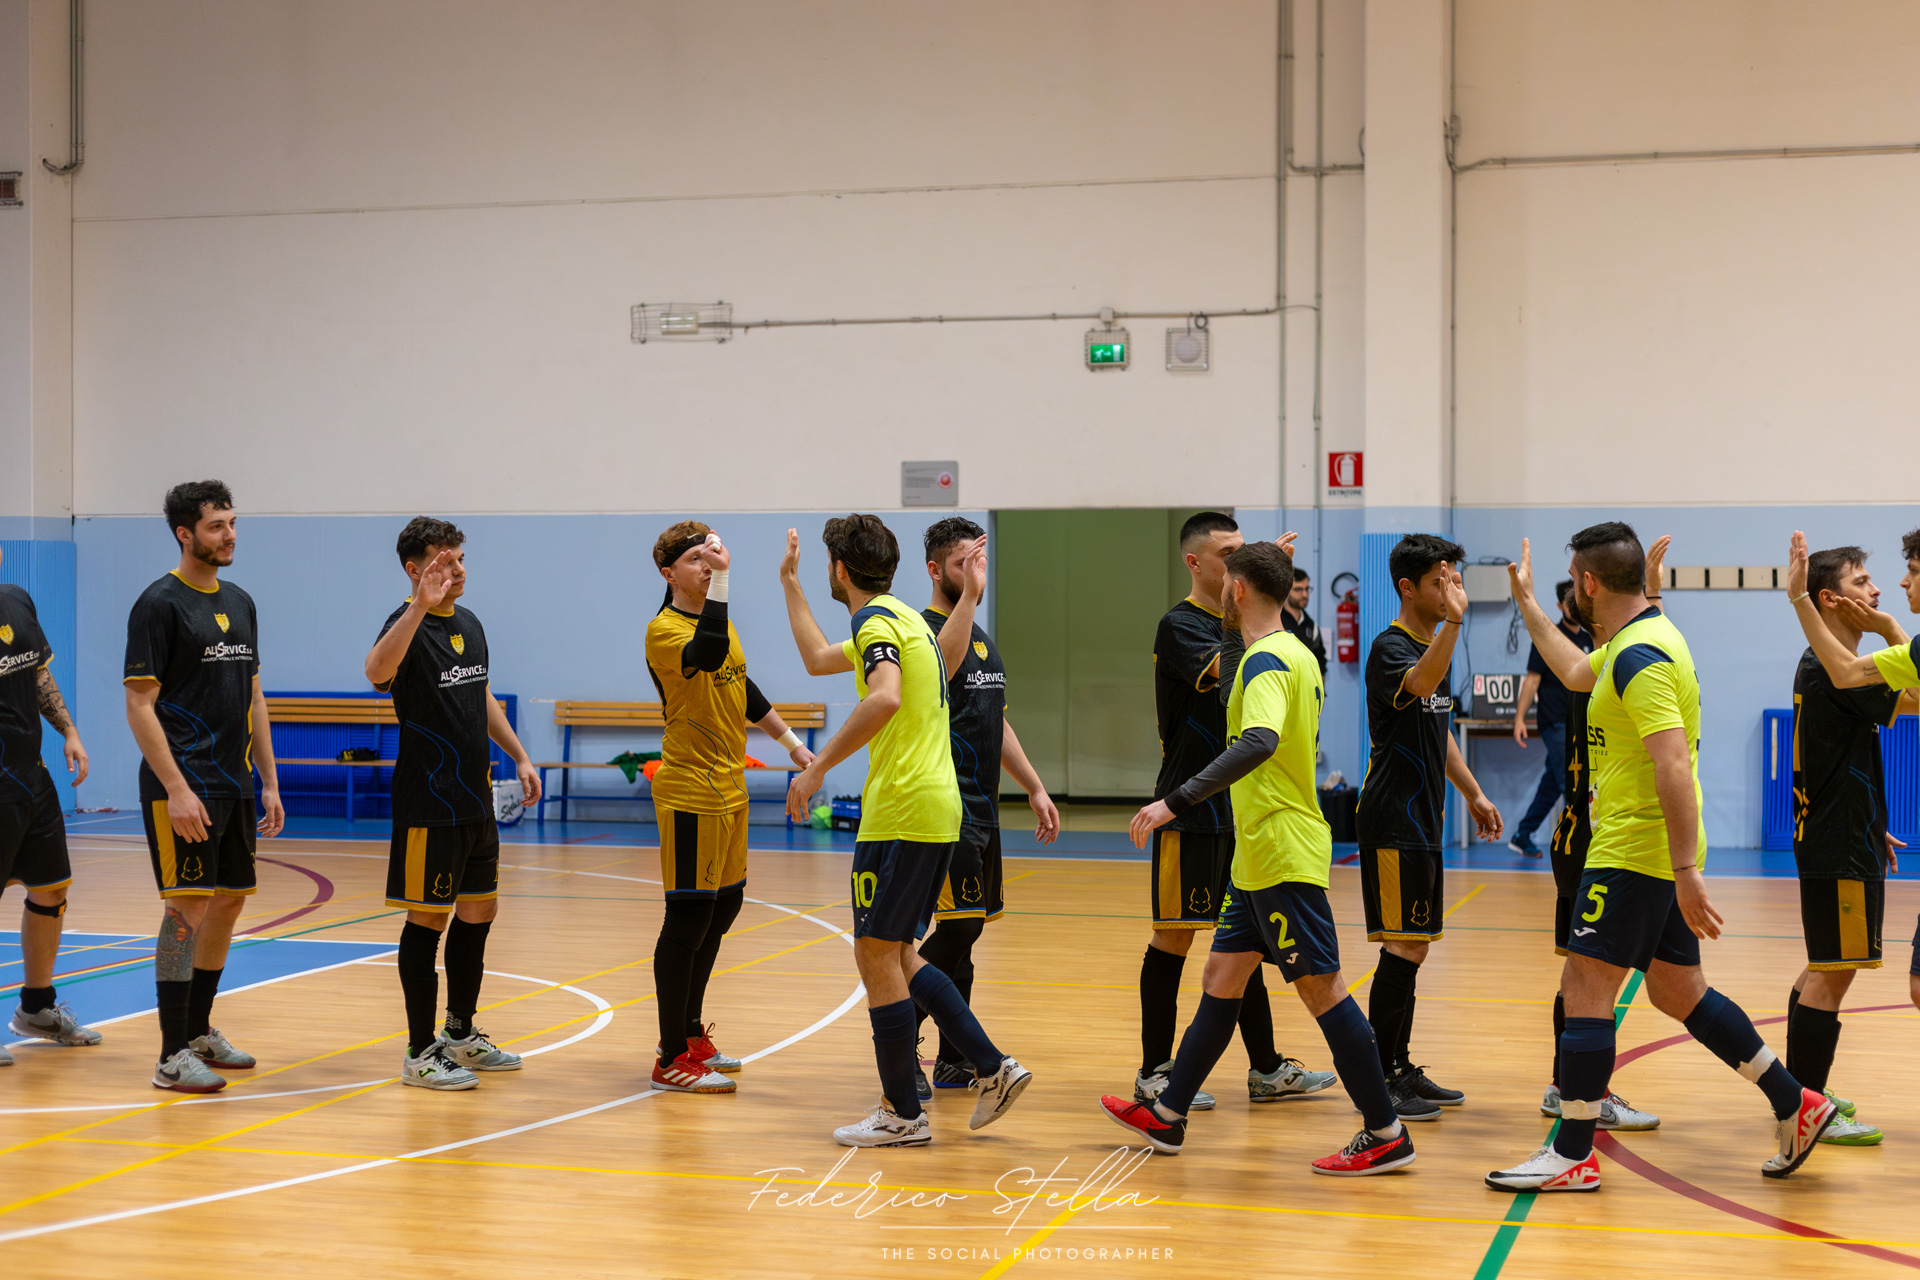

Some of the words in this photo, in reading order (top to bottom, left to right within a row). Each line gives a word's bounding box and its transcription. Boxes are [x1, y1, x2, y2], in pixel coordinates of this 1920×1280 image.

[440, 664, 483, 683] ALLSERVICE
[966, 669, 1004, 685] ALLSERVICE
[1489, 679, 1511, 700] 00
[852, 871, 878, 908] 10
[1581, 883, 1608, 922] 5
[1269, 911, 1296, 950] 2
